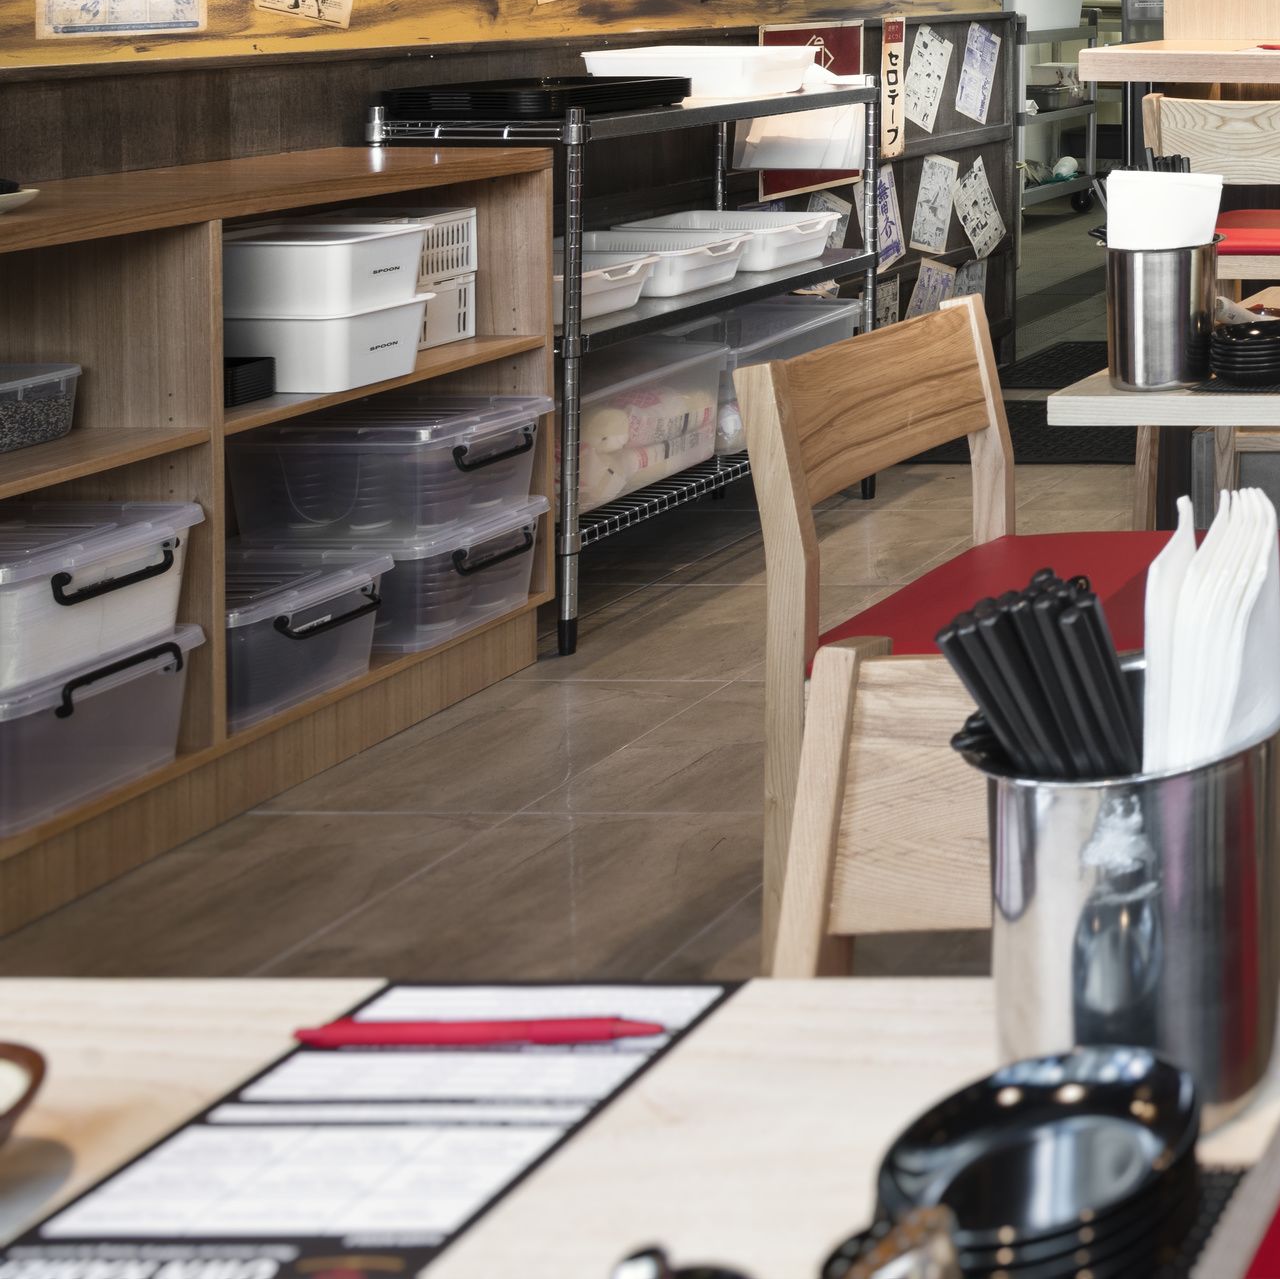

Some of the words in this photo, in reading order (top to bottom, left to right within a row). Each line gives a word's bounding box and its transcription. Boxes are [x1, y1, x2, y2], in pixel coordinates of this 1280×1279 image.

[887, 51, 900, 145] セロテープ
[373, 265, 400, 274] SPOON
[369, 340, 399, 351] SPOON
